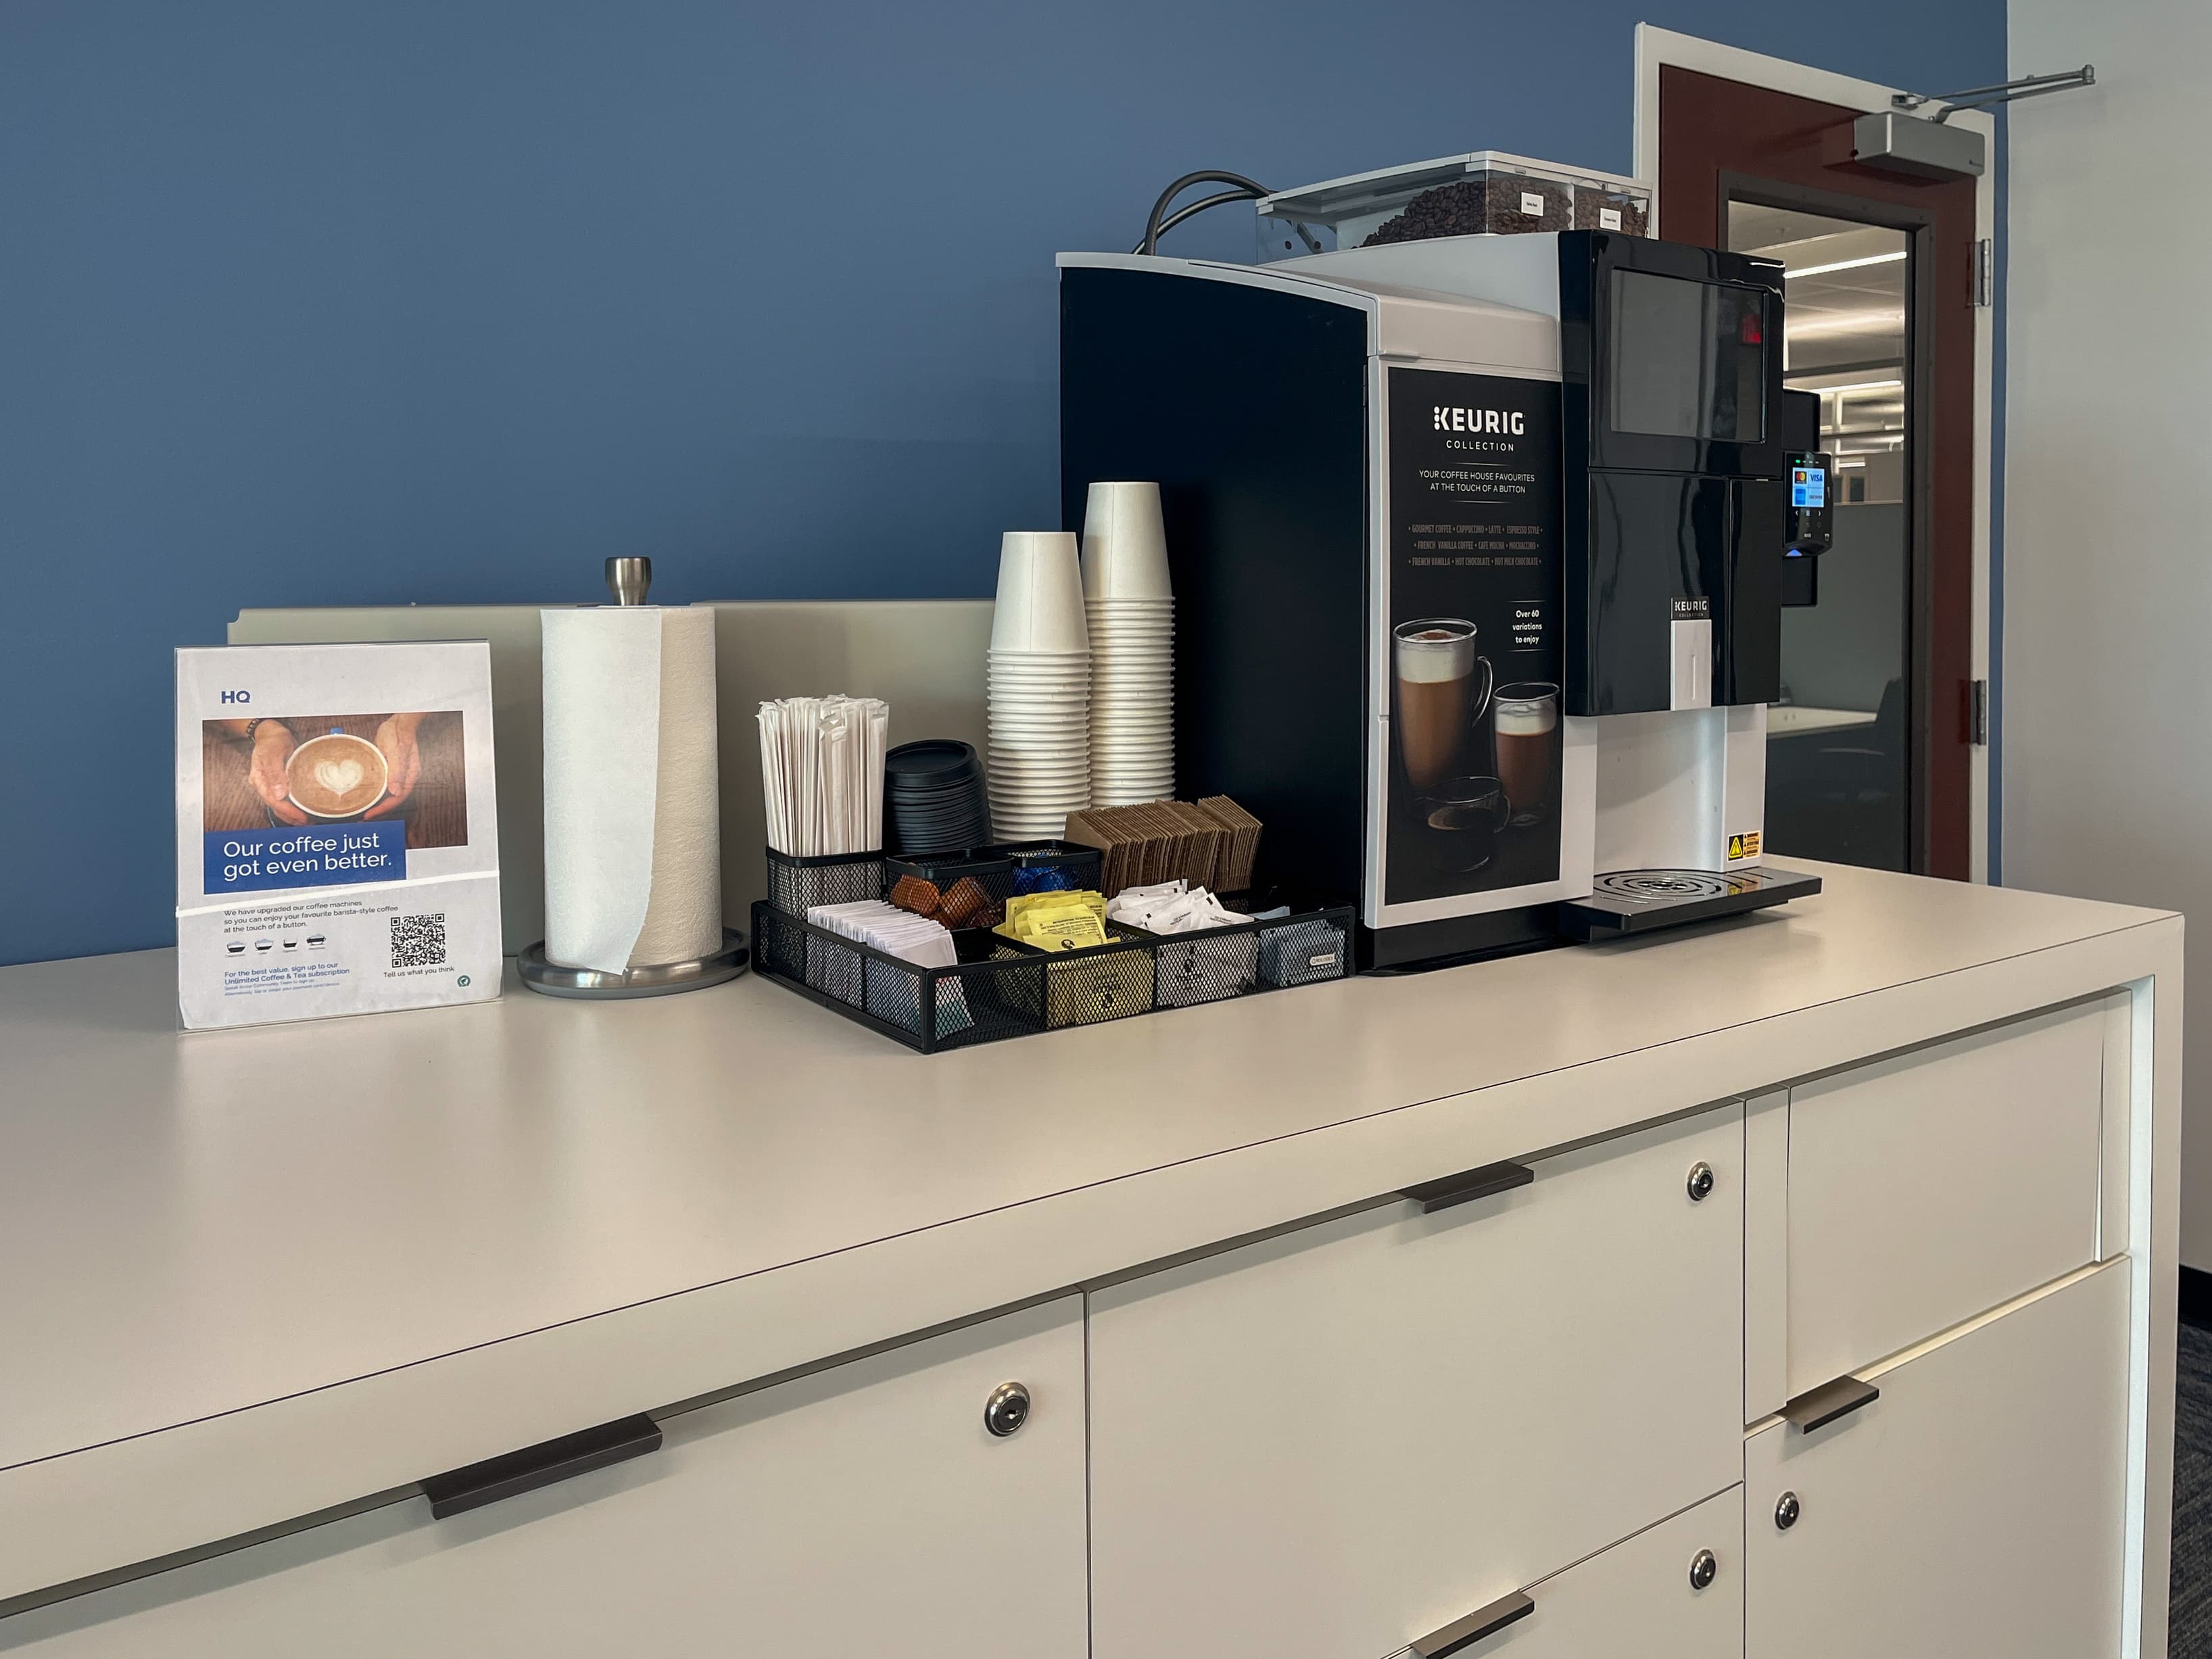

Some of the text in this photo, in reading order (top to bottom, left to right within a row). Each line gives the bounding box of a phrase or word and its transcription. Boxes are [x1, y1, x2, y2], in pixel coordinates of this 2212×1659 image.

[1434, 406, 1524, 435] KEURIG
[1447, 440, 1514, 452] COLLECTION
[1420, 471, 1535, 482] YOUR COFFEE HOUSE FAVOURITES
[1810, 474, 1823, 482] VISA
[1441, 483, 1455, 491] THE
[1457, 484, 1481, 492] TOUCH
[1499, 485, 1526, 494] BUTTON
[1412, 525, 1434, 533] GOURMET
[1435, 525, 1452, 533] COFFEE
[1489, 525, 1501, 534] LATTE
[1528, 526, 1539, 534] STYLE
[1418, 541, 1436, 550] FRENCH
[1438, 542, 1457, 550] VANILLA
[1458, 542, 1474, 550] COFFEE
[1490, 542, 1505, 550] MOCHA
[1412, 557, 1431, 566] FRENCH
[1432, 557, 1450, 566] VANILLA
[1455, 558, 1464, 566] HOT
[1466, 558, 1491, 566] CHOCOLATE
[1515, 558, 1539, 566] CHOCOLATE
[1675, 601, 1707, 612] KEURIG
[1516, 610, 1531, 618] Over
[1512, 623, 1542, 631] variations
[1515, 635, 1539, 645] to enjoy
[221, 691, 251, 704] HQ
[224, 833, 379, 858] Our coffee just
[223, 852, 391, 882] got even better.
[257, 905, 291, 915] upgraded
[234, 917, 247, 925] you
[264, 914, 283, 922] enjoy
[285, 913, 299, 921] your
[302, 910, 332, 919] favourite
[333, 907, 375, 916] barista-style
[224, 977, 260, 985] Unlimited
[308, 968, 350, 978] subscription
